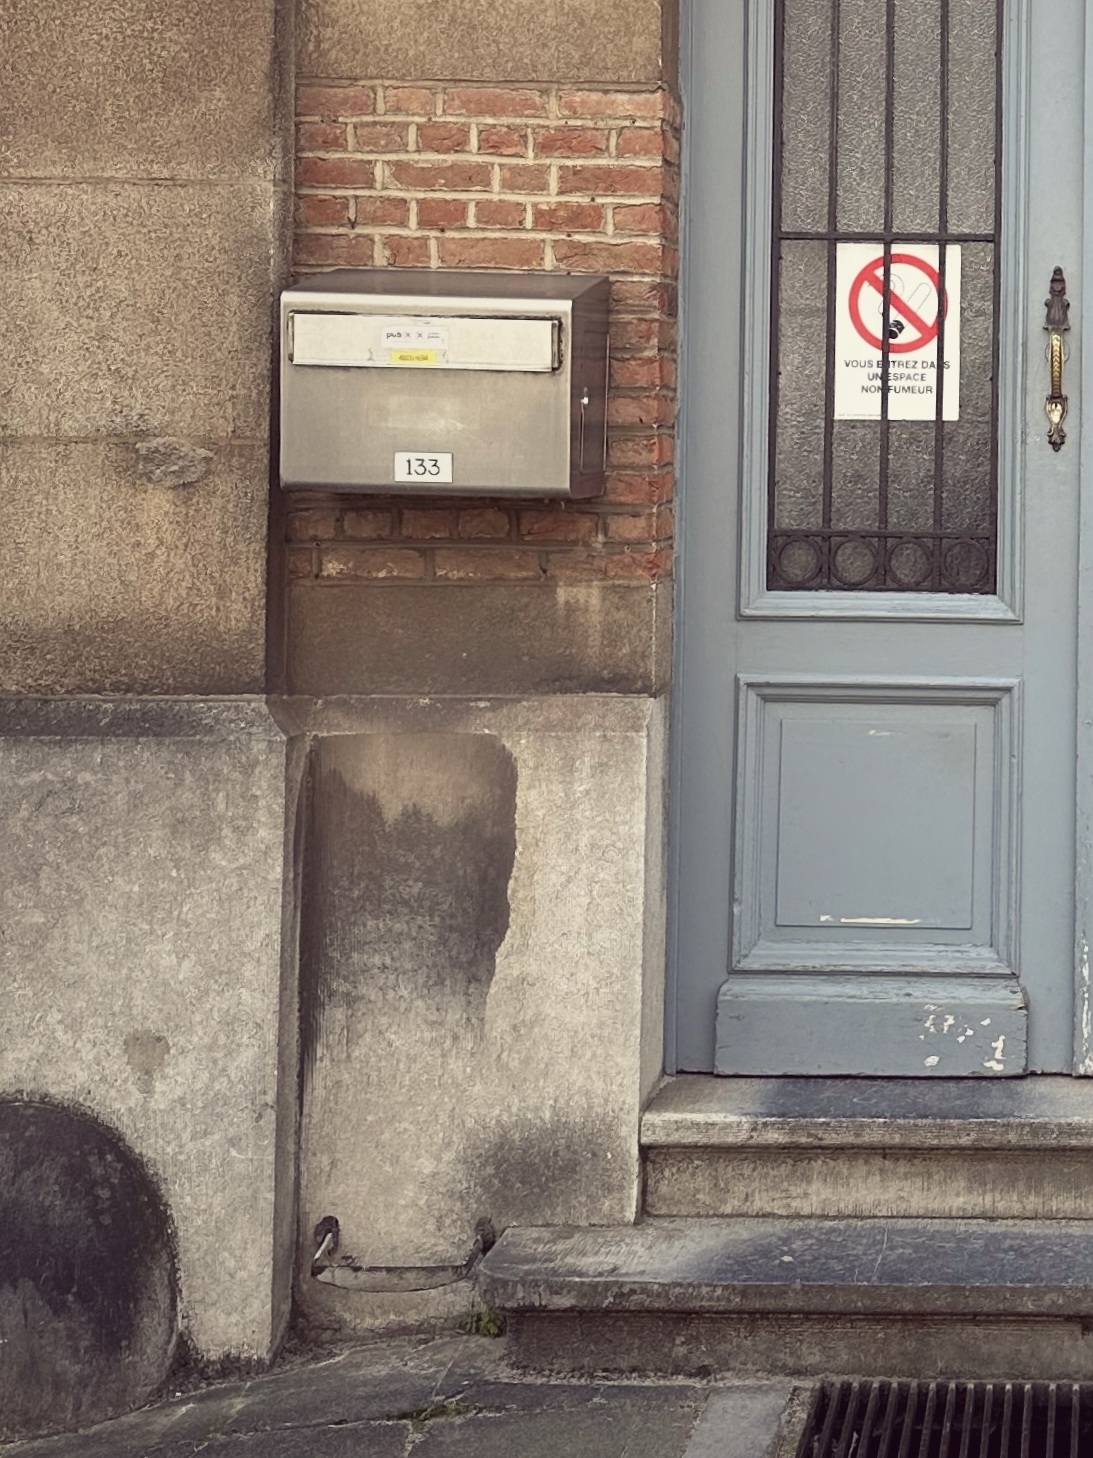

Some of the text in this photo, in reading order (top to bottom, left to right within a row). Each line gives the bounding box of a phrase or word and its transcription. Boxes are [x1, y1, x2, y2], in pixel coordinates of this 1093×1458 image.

[844, 360, 950, 370] VOUS ETREZ DAS
[868, 373, 926, 381] UN ESPACE
[888, 386, 933, 394] FUMEUR
[406, 458, 440, 475] 133
